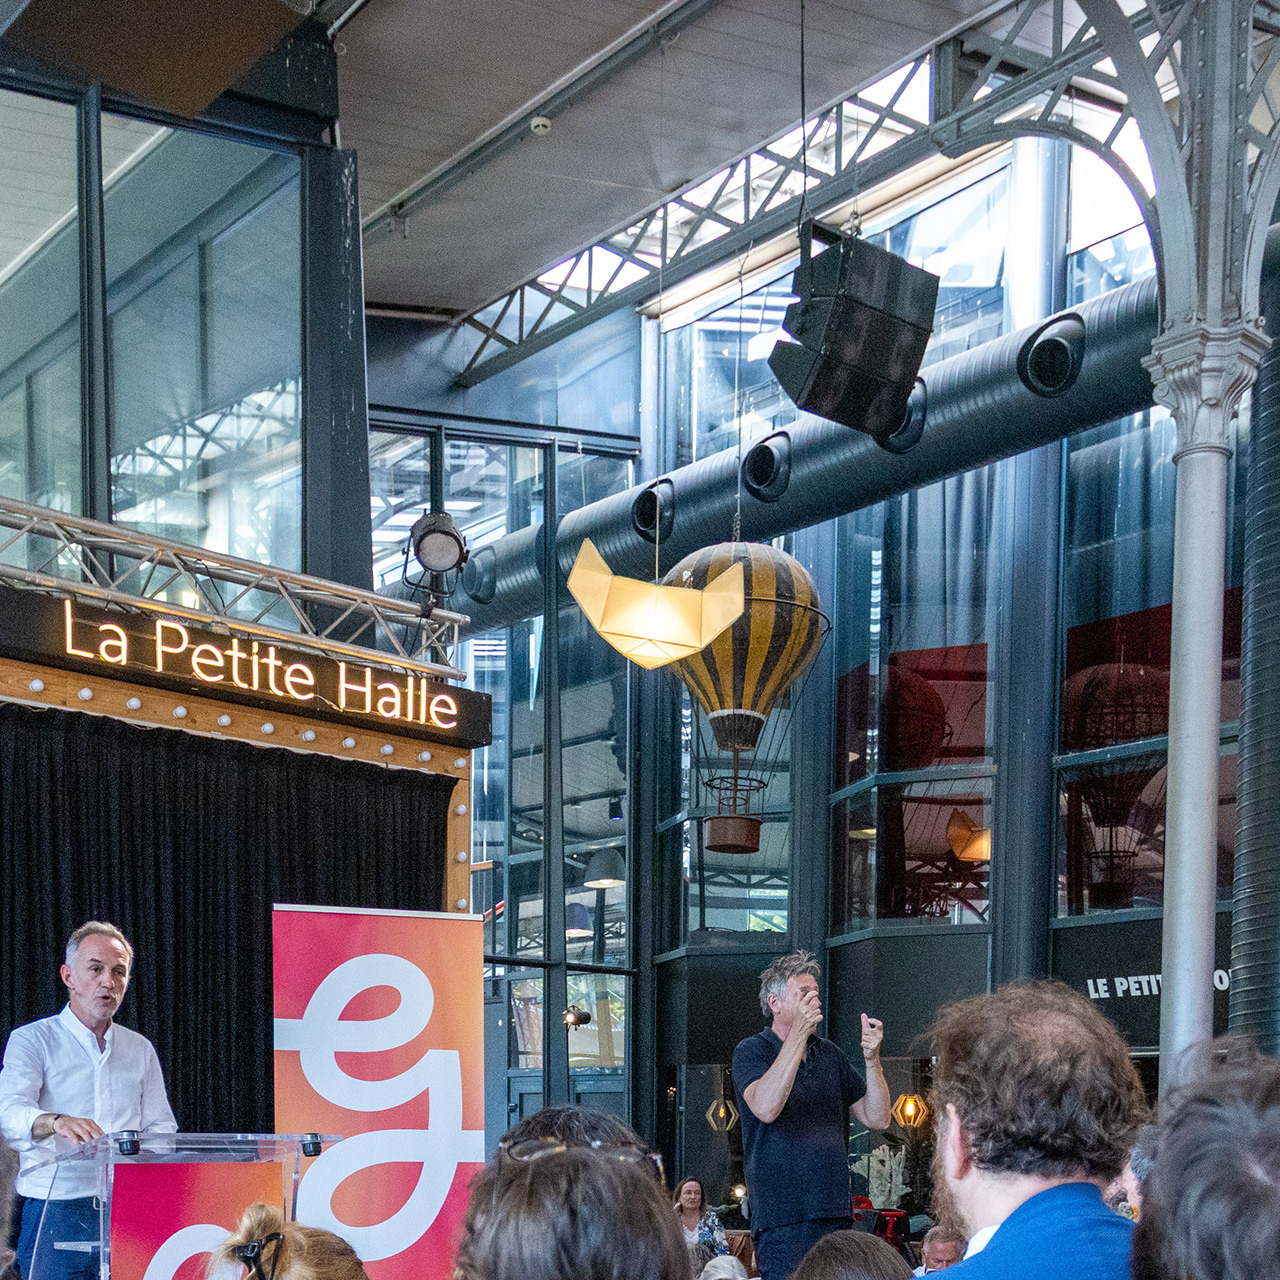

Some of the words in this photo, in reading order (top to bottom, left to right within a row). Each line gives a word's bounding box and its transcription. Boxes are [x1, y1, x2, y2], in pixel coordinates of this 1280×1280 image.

[64, 599, 128, 666] La
[154, 618, 316, 700] Petite
[338, 661, 458, 729] Halle
[1087, 978, 1110, 998] LE
